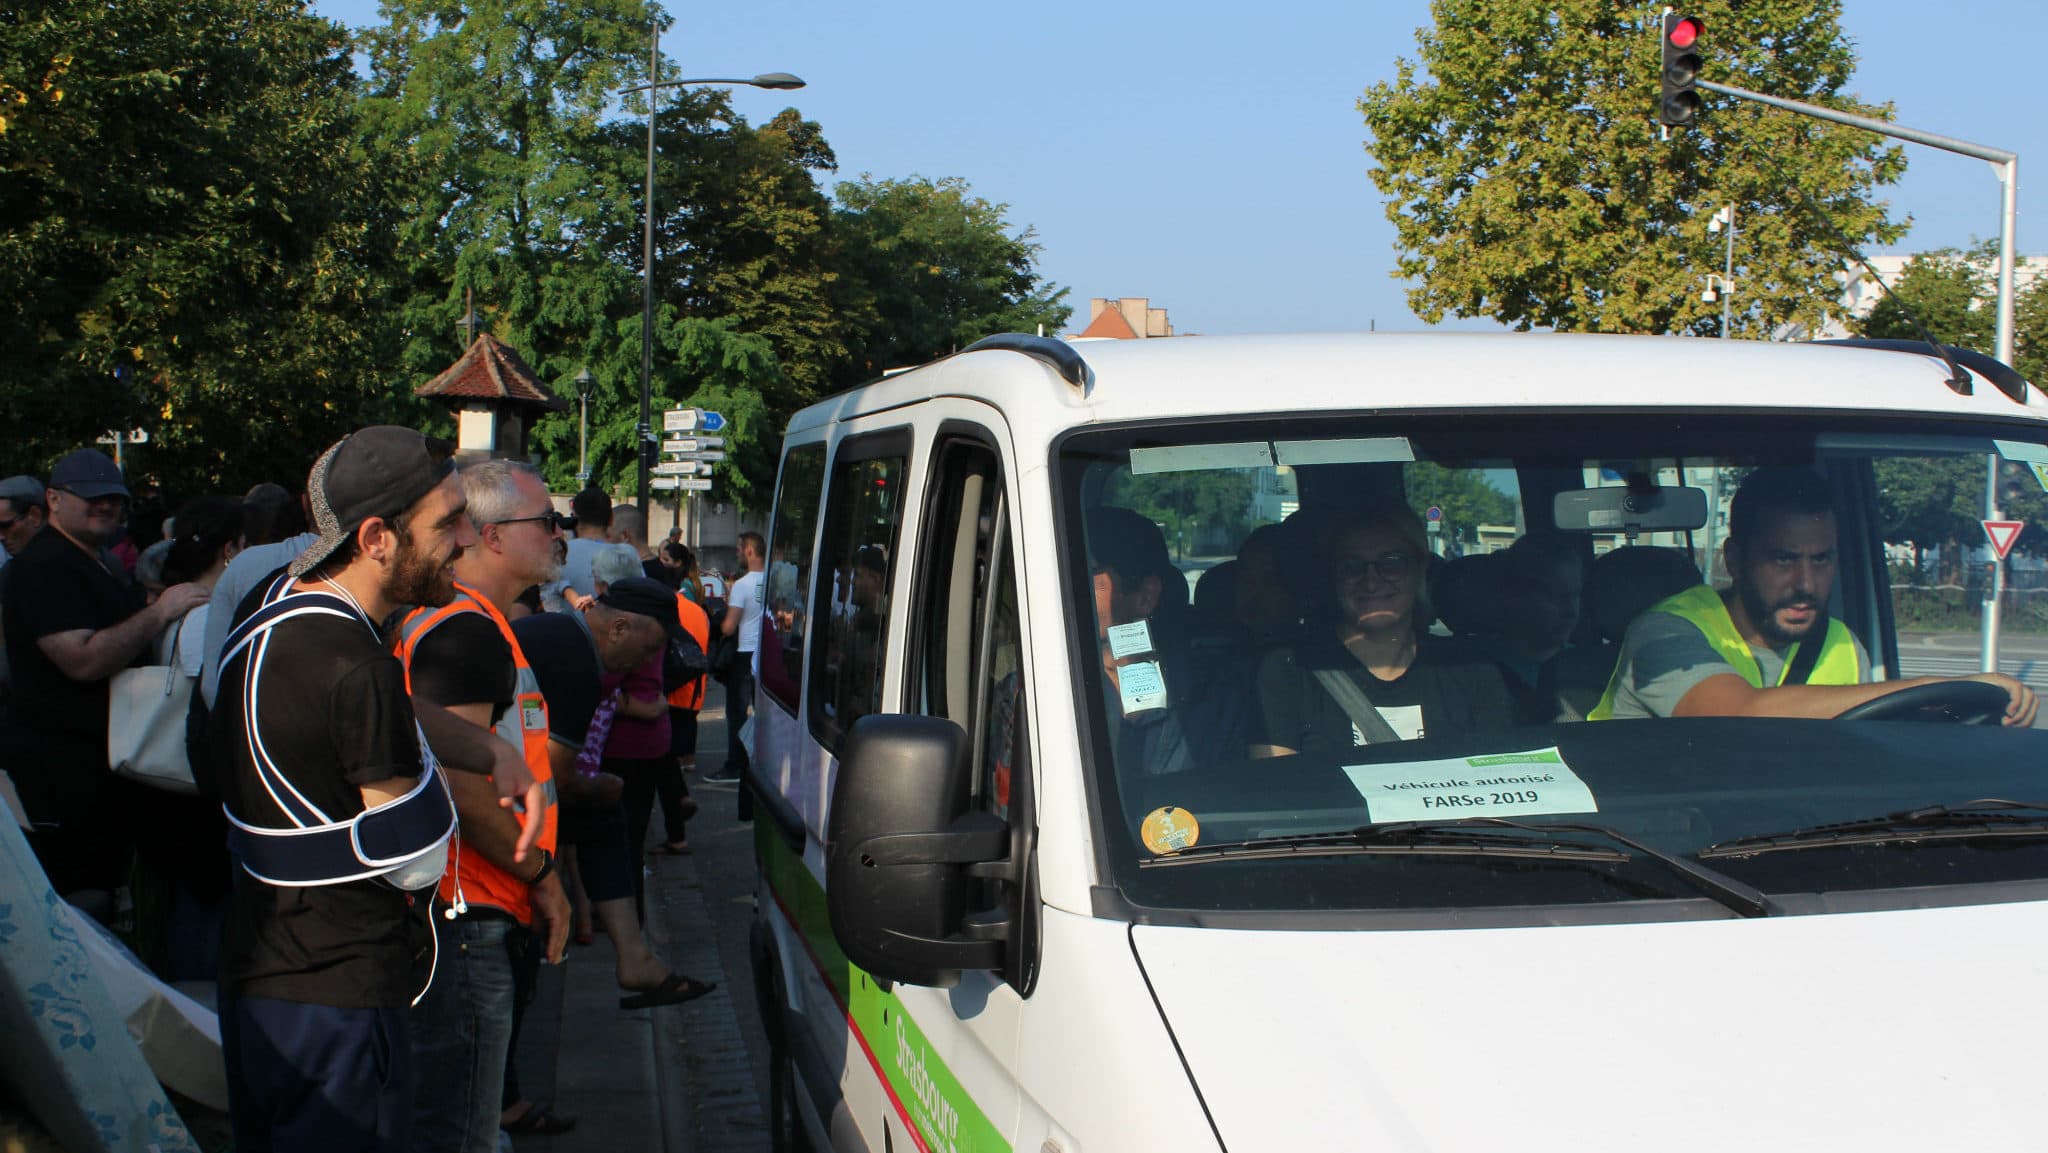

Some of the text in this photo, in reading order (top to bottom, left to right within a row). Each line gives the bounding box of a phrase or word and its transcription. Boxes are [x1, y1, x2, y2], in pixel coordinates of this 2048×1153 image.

[1384, 774, 1554, 791] Véhicule autorisé
[1424, 790, 1538, 808] FARSe 2019
